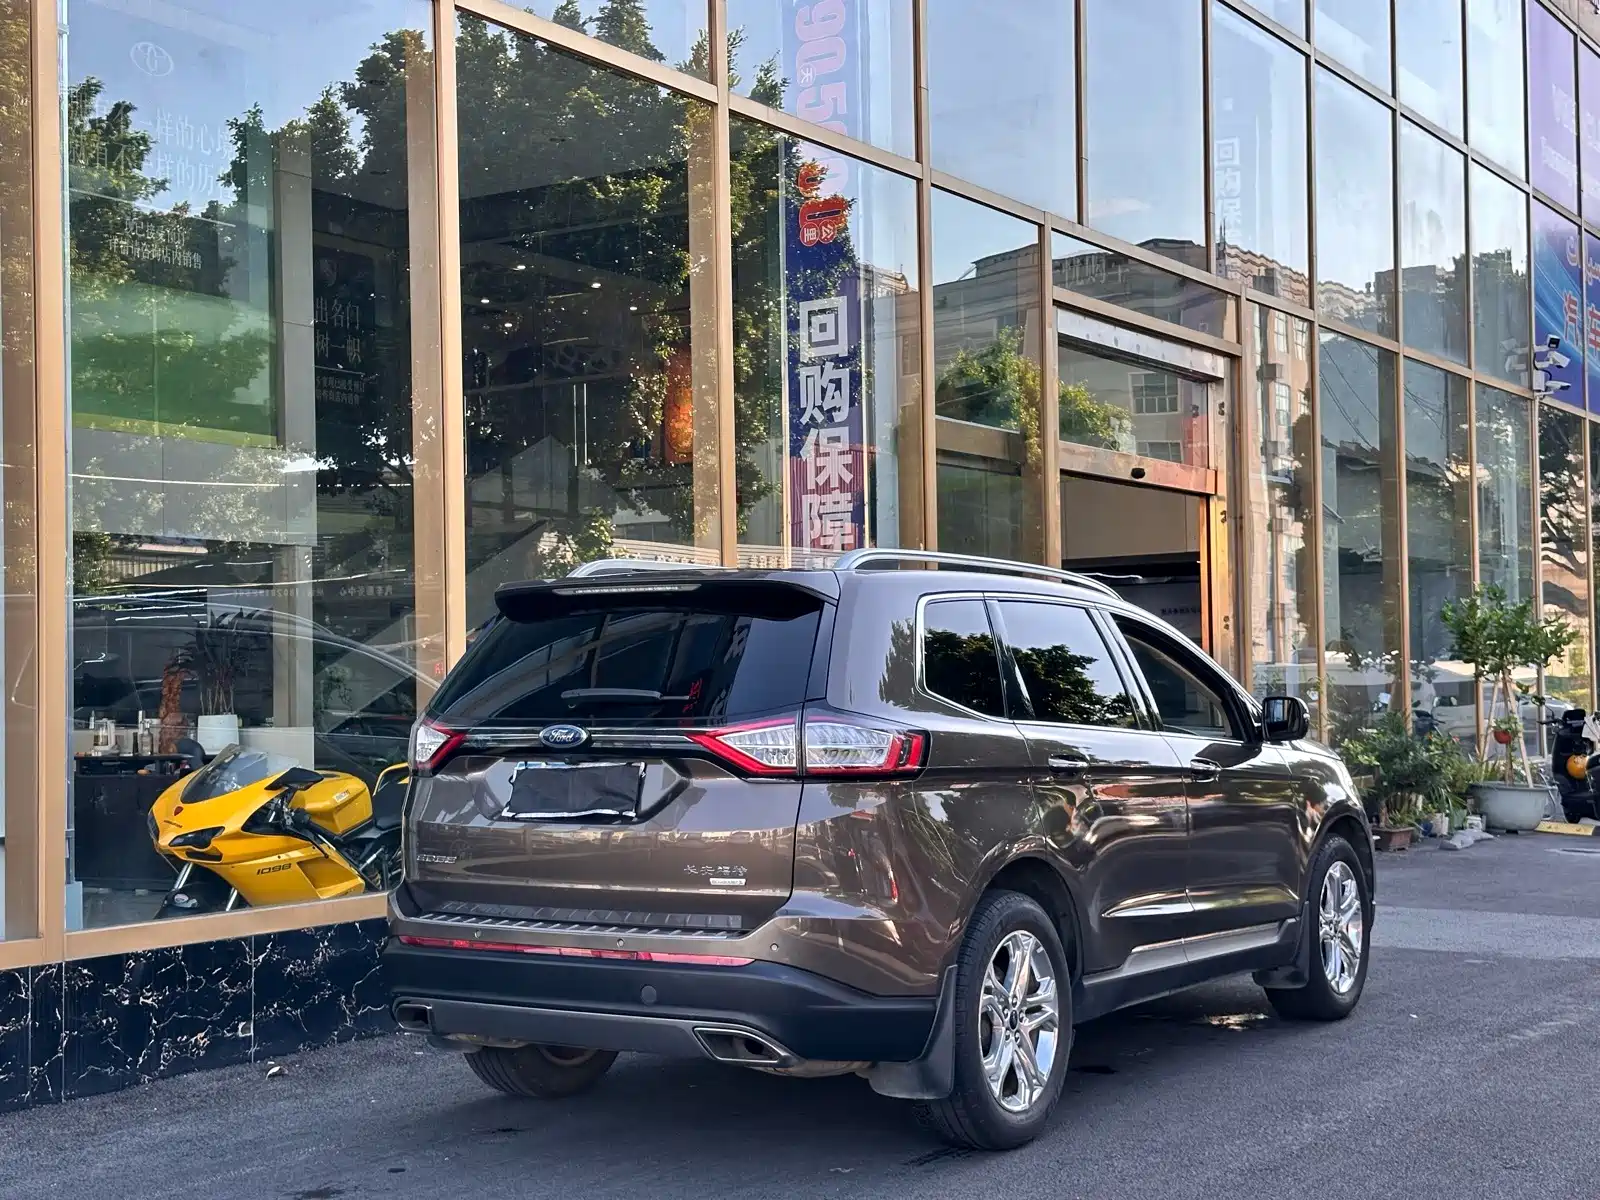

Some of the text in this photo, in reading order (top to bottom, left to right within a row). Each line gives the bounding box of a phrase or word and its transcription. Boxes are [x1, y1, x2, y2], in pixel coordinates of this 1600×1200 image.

[799, 295, 855, 555] 回购保障
[549, 729, 576, 743] Ford
[256, 862, 292, 876] 1098
